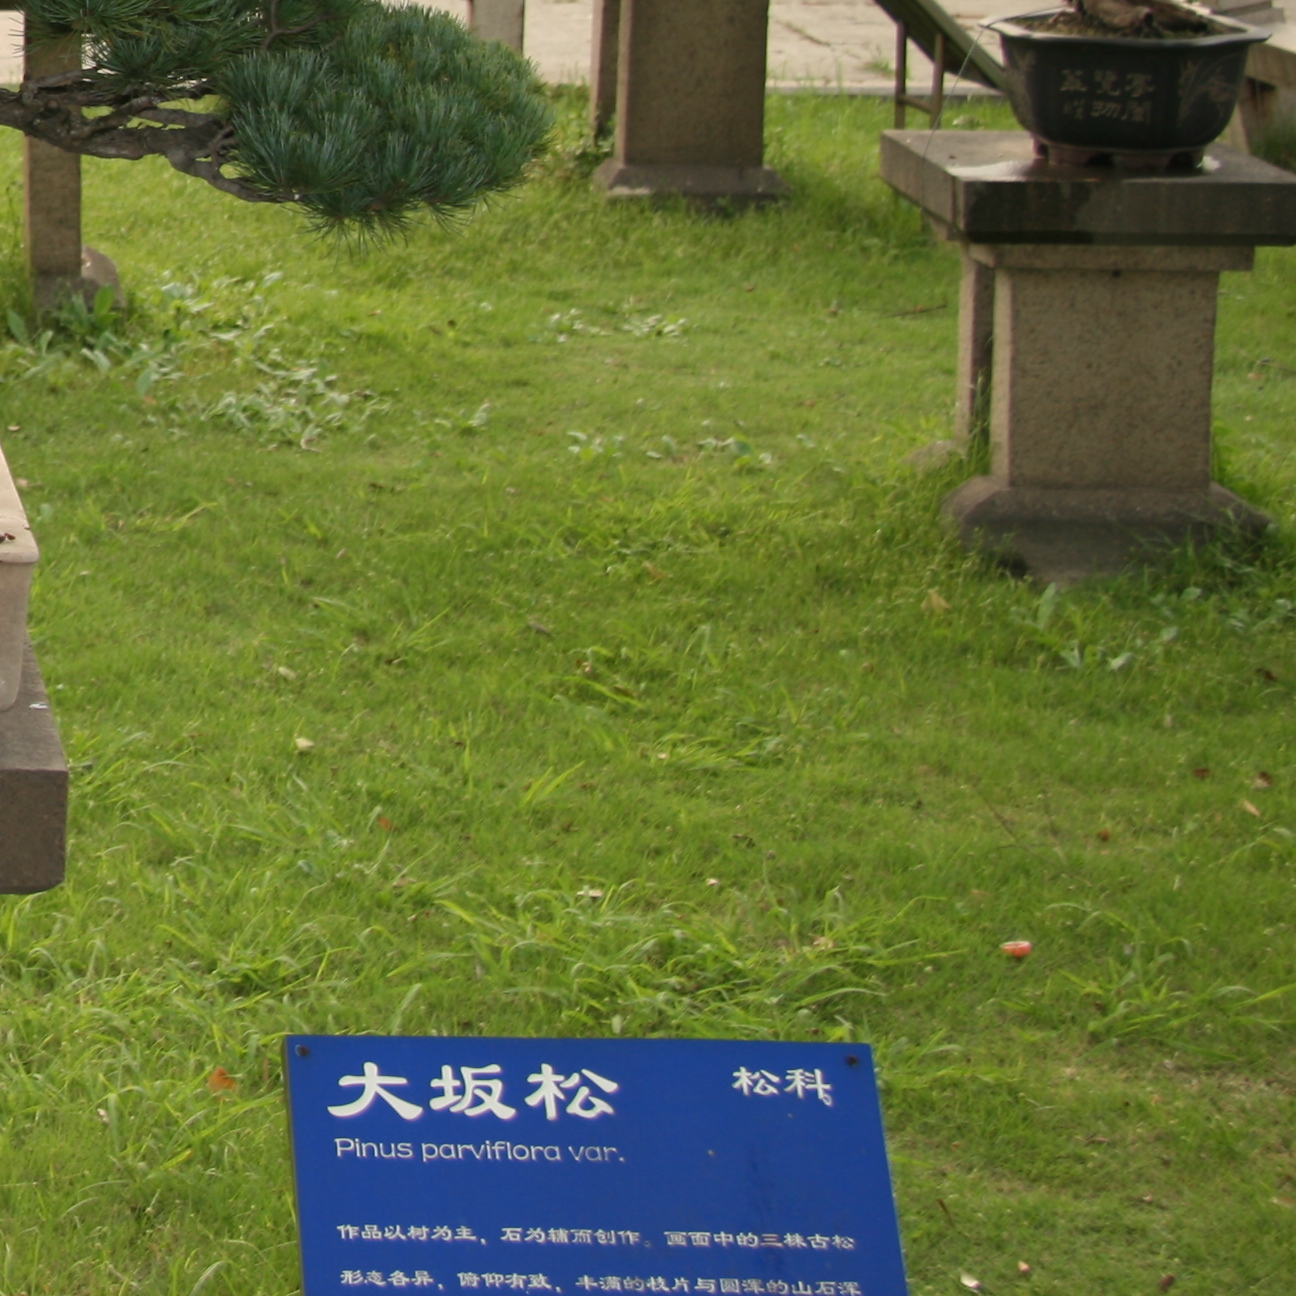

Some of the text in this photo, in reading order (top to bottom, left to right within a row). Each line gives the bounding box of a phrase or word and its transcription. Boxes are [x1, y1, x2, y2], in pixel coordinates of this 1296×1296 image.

[327, 1061, 619, 1121] 大坂松
[334, 1137, 626, 1163] Pinus parviflora var.
